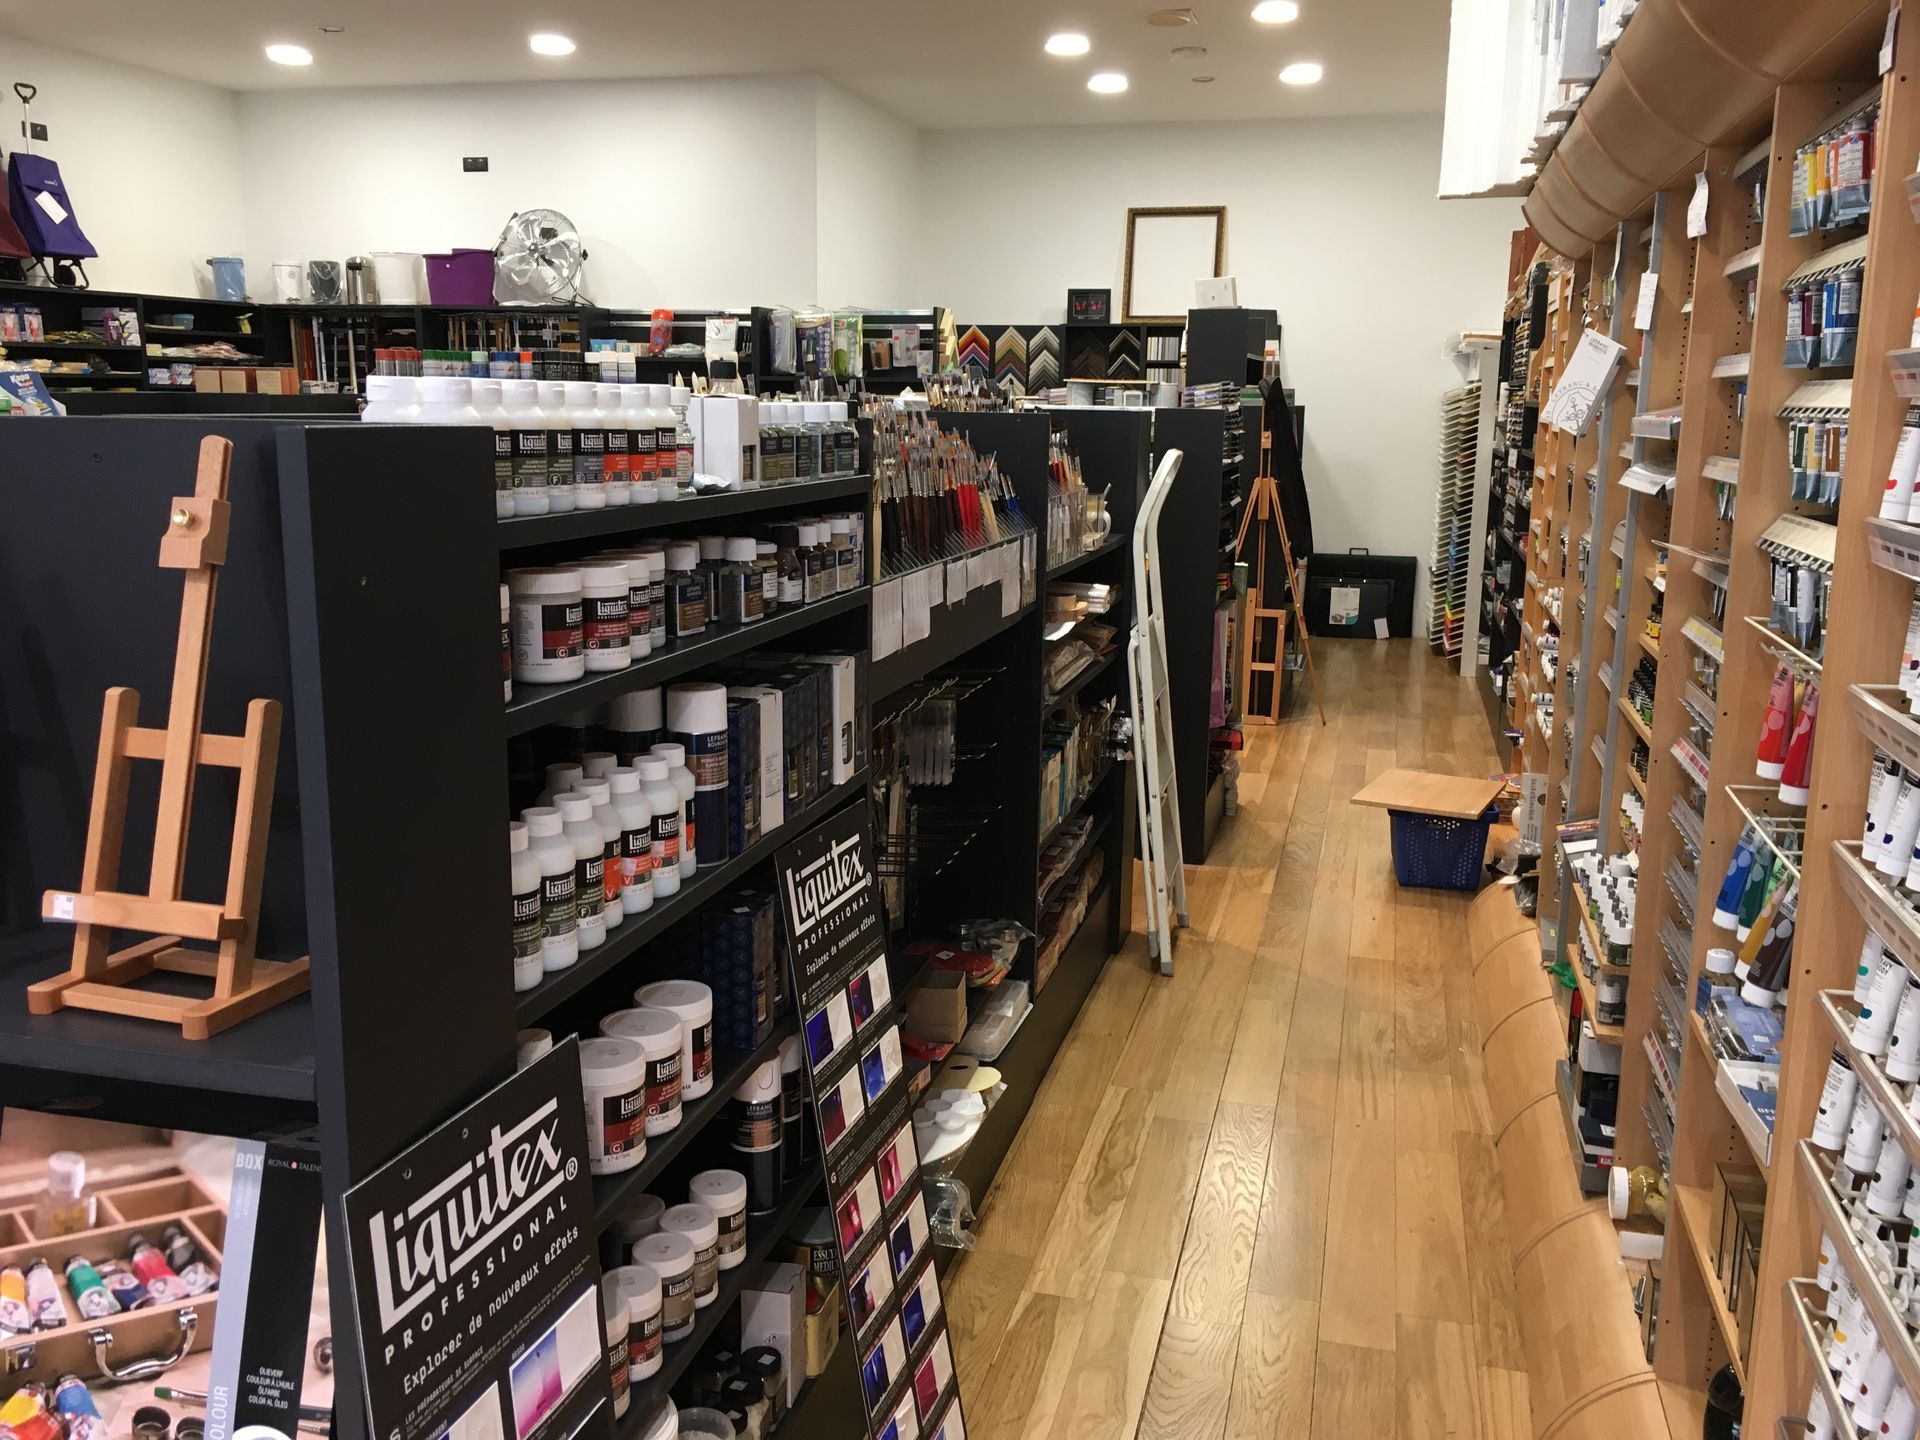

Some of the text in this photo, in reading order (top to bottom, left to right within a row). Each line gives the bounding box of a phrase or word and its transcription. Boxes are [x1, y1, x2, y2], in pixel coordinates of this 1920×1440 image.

[519, 432, 547, 449] Liquit
[707, 734, 728, 743] LEFRAN
[545, 874, 576, 898] Liquit
[786, 833, 867, 937] Liquitex
[513, 893, 541, 917] Liquit
[797, 893, 869, 955] PROFESSIONAL
[235, 1152, 264, 1170] BOX
[268, 1158, 290, 1168] ROYAL
[369, 1097, 564, 1334] Liquitex
[384, 1196, 567, 1365] PROFESSIONAL
[403, 1333, 463, 1395] Explorer
[468, 1313, 483, 1335] de
[489, 1262, 540, 1317] nouveaux
[544, 1226, 578, 1265] effets
[246, 1374, 271, 1386] COULEUR
[276, 1379, 295, 1390] L'HUILE
[248, 1394, 266, 1404] COLOR
[209, 1385, 229, 1440] OLOUR
